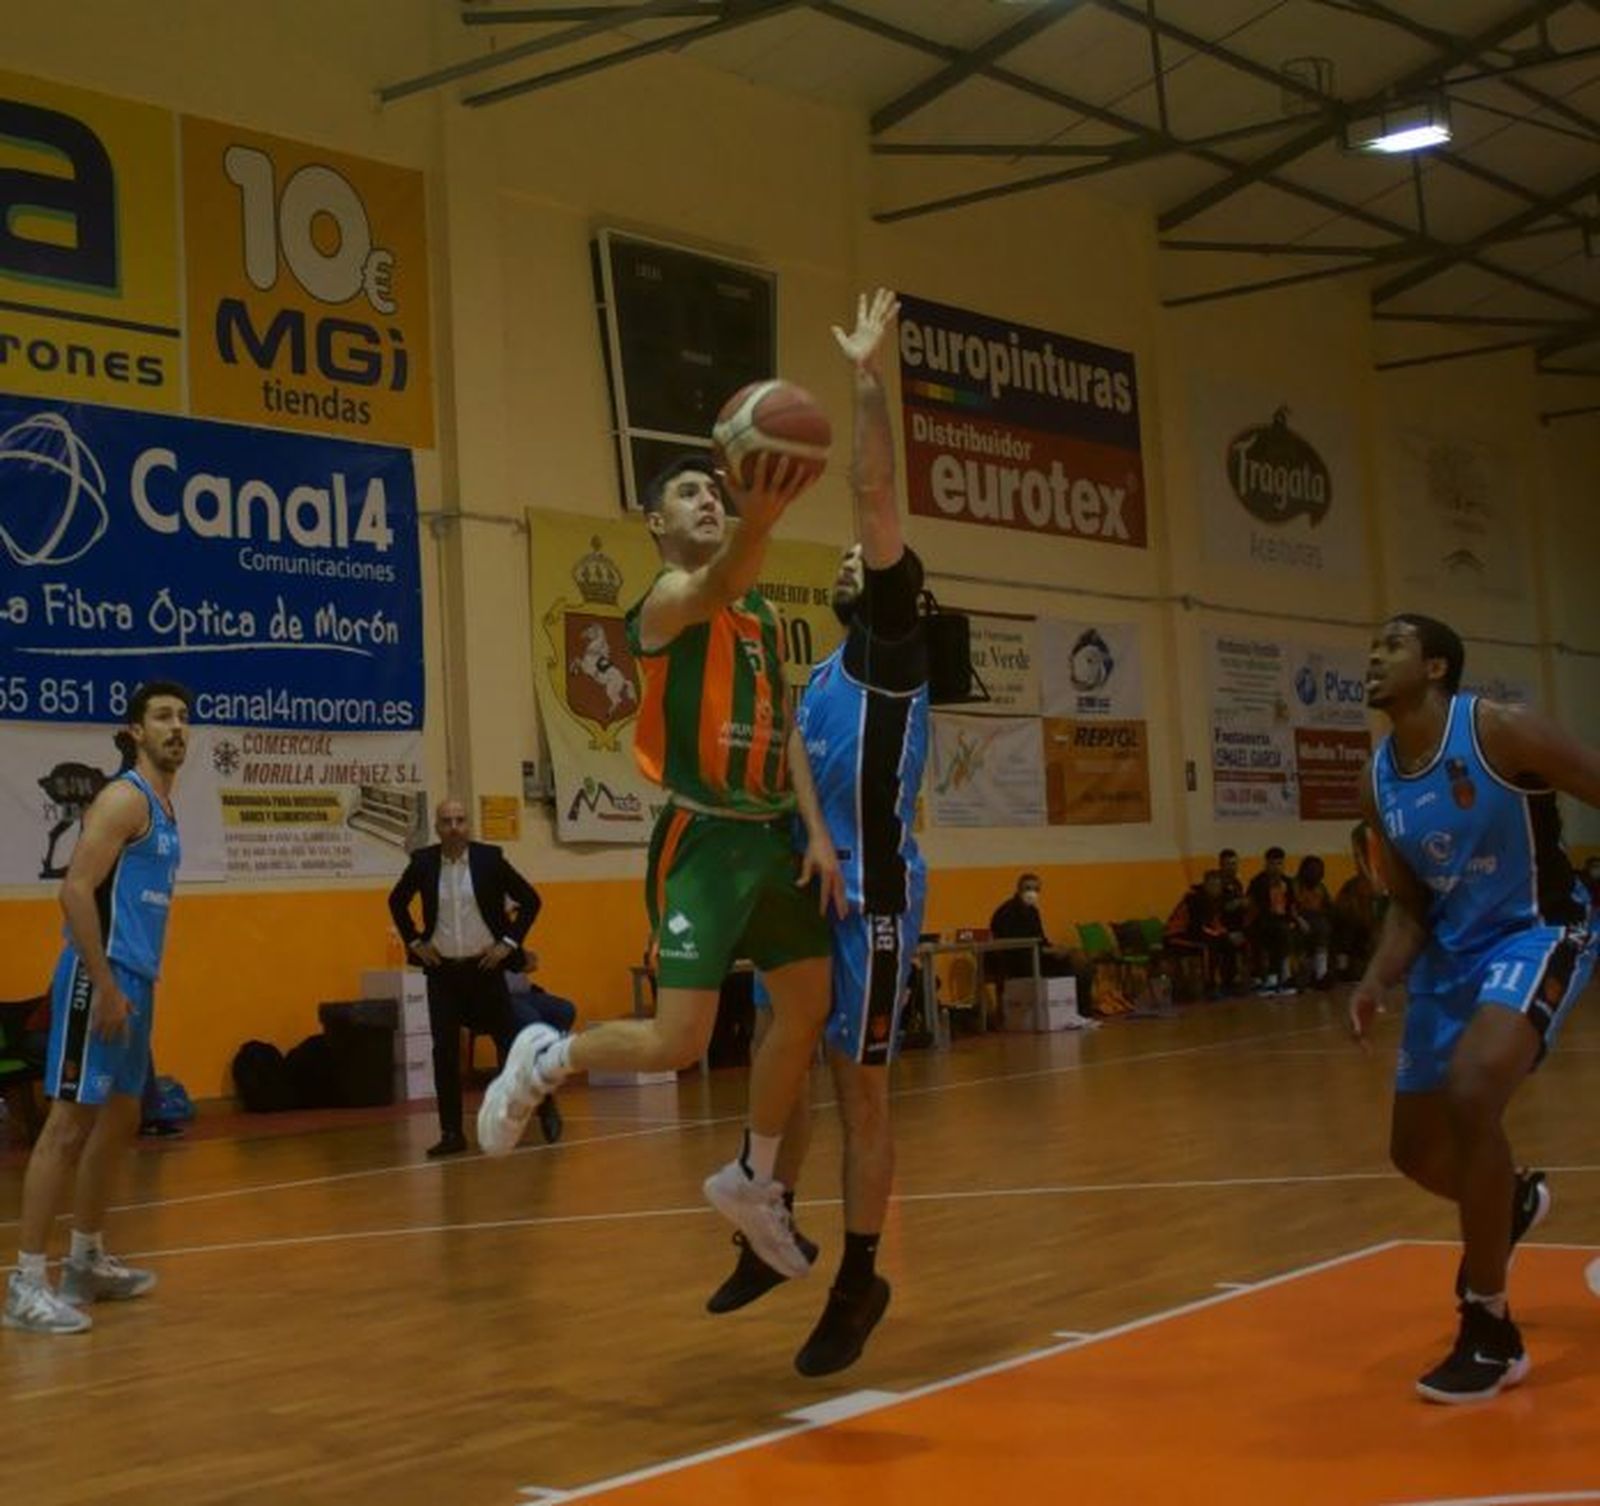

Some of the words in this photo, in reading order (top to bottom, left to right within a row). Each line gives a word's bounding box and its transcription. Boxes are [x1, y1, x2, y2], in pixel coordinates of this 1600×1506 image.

[222, 144, 396, 316] 10€
[901, 318, 1133, 414] europinturas
[262, 380, 372, 425] tiendas
[911, 412, 1033, 461] Distribuidor
[931, 454, 1131, 540] eurotex
[238, 546, 396, 583] Comunicaciones
[42, 582, 133, 630] Fibra
[148, 586, 257, 646] Óptica
[269, 594, 304, 642] de
[314, 600, 399, 646] Morón
[40, 677, 96, 714] 851
[196, 687, 414, 726] canal4moron.es
[242, 734, 333, 756] COMERCIAL
[1073, 726, 1141, 748] REPSOL
[243, 761, 314, 785] MORILLA
[319, 757, 390, 786] JIMÉNEZ
[1483, 962, 1525, 992] 31
